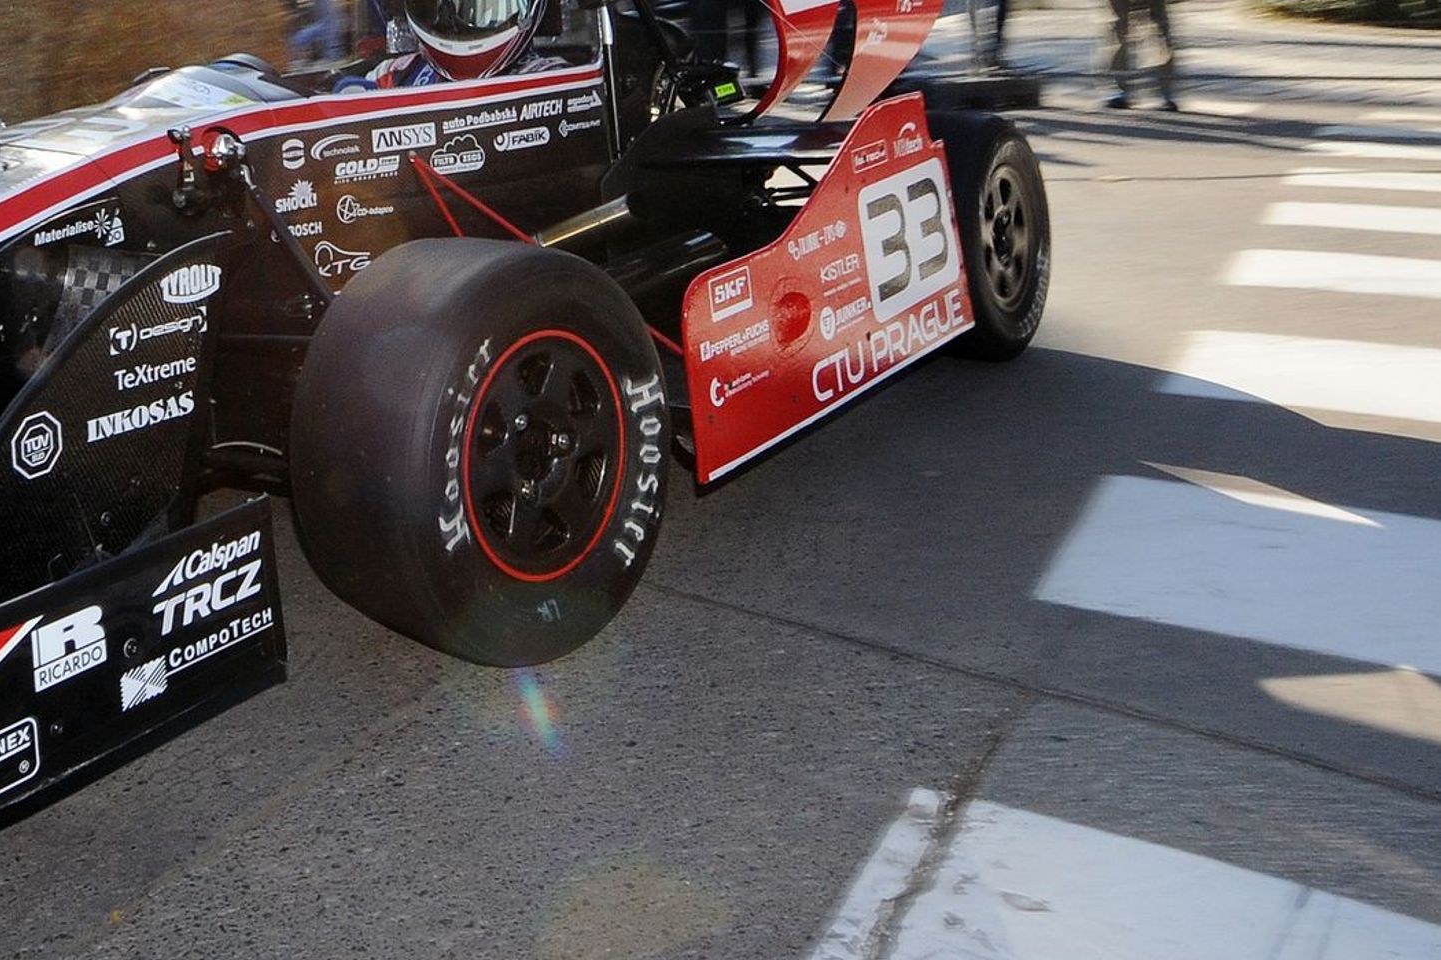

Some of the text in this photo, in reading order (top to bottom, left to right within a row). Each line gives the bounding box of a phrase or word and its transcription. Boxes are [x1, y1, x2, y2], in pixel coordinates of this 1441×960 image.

[442, 117, 466, 129] auto
[520, 99, 563, 121] AIRTECH
[376, 126, 434, 149] ANSYS
[335, 159, 378, 176] GOLD
[34, 220, 94, 247] Materialise
[866, 177, 949, 303] 33
[714, 276, 747, 304] SKF
[812, 288, 965, 402] CTU PRAGUE
[114, 356, 196, 390] TeXtreme
[87, 390, 195, 443] INKOSAS
[186, 530, 261, 580] Calspan
[152, 559, 262, 637] TRCZ
[38, 646, 103, 687] RICARDO
